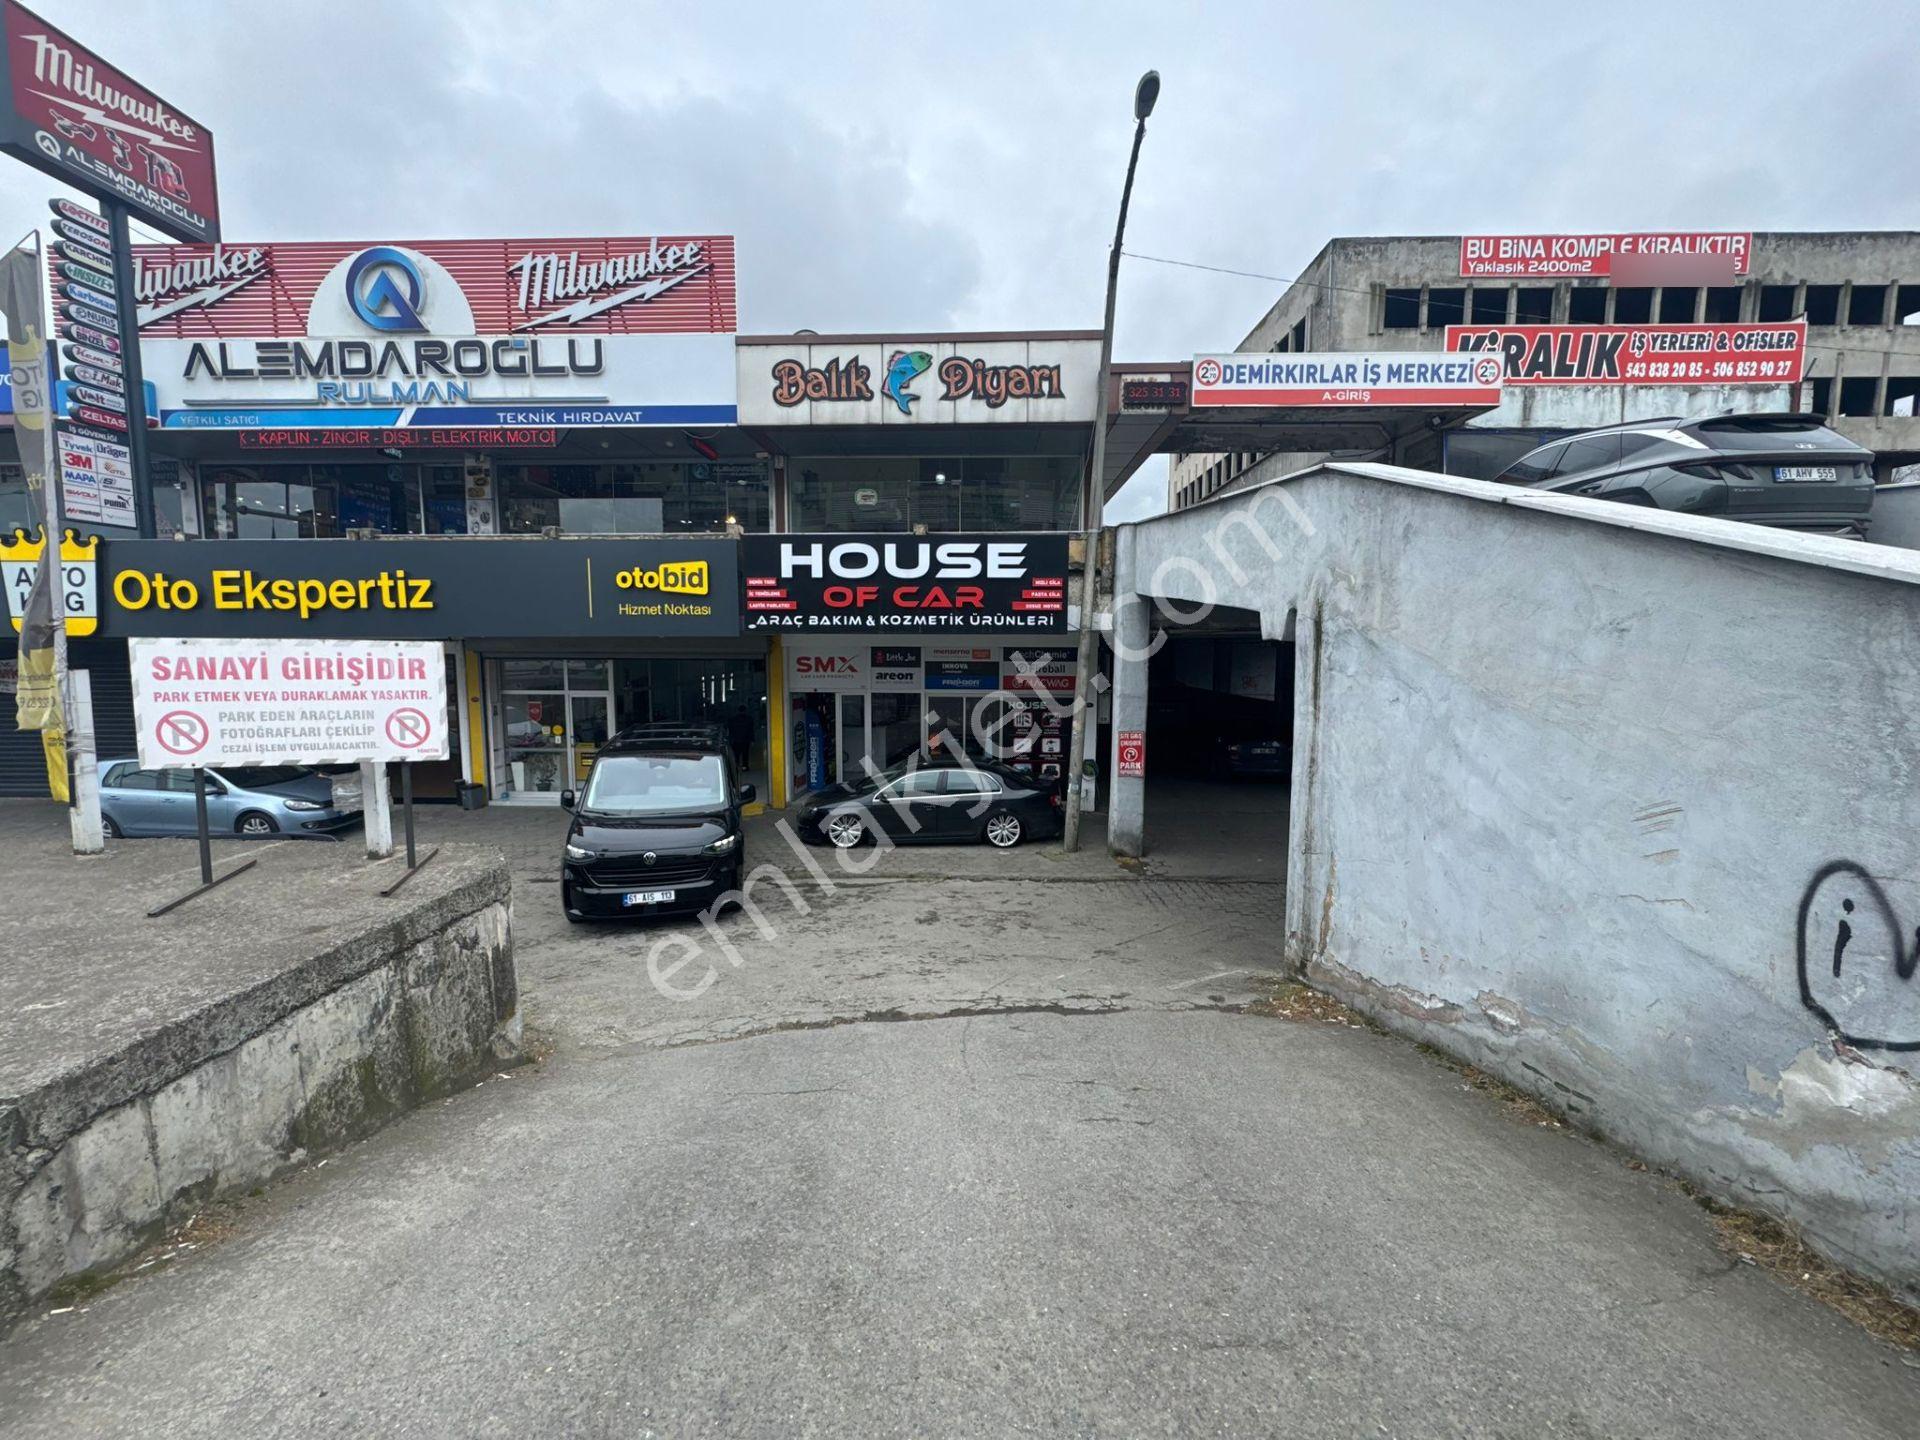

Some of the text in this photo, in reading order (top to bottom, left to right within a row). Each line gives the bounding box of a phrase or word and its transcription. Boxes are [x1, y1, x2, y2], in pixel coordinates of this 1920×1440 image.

[19, 34, 197, 142] Milwaukee
[115, 183, 166, 214] RULMAN
[60, 202, 108, 230] LOCTITE
[62, 223, 109, 249] TEROSON
[1466, 239, 1494, 259] BU
[1551, 237, 1633, 258] KOMPLE
[132, 243, 265, 301] lwaukee
[507, 237, 702, 311] Milwaukee
[1467, 260, 1593, 274] Yaklaşık 2400m2
[72, 267, 108, 289] INSIZE
[69, 284, 116, 311] Karbosan
[1716, 331, 1728, 351] &
[1201, 366, 1209, 379] 2
[1222, 357, 1475, 386] DEMİRKIRLAR İŞ MERKEZİ
[1480, 365, 1488, 378] 2
[1625, 363, 1646, 377] 543
[1649, 363, 1669, 377] 838
[1671, 363, 1686, 377] 20
[1689, 362, 1702, 377] 85
[1713, 362, 1733, 377] 506
[1736, 362, 1757, 377] 852
[1759, 361, 1774, 376] 90
[1776, 361, 1792, 376] 27
[316, 380, 471, 406] RULMAN
[1129, 386, 1181, 398] 325 31 31
[1322, 389, 1371, 402] A-GİRİŞ
[223, 415, 259, 425] SATICI
[496, 408, 643, 424] TEKNİK HIRDAVAT
[63, 440, 92, 454] Tyvek
[96, 442, 128, 459] Dräger
[65, 452, 92, 470] 3M
[65, 470, 97, 484] MAPA
[1781, 468, 1835, 478] 61 AHV 555
[104, 498, 127, 509] PUMA
[780, 541, 1028, 579] HOUSE
[15, 566, 86, 588] AO
[20, 591, 85, 612] KG
[113, 569, 434, 620] Oto Ekspertiz
[823, 586, 984, 608] OF CAR
[619, 603, 712, 616] Hizmet Noktası
[756, 612, 1055, 628] ARAÇ BAKIM & KOZMETİK ÜRÜNLERİ
[152, 651, 427, 687] SANAYİ GİRİŞİDİR
[796, 655, 859, 673] SMX
[875, 671, 914, 681] areon
[153, 689, 433, 703] PARK ETMEK VEYA DURAKLAMAK YASAKTIR.
[219, 709, 375, 723] PARK EDEN ARAÇLARIN
[220, 723, 375, 739] FOTOĞRAFLARI ÇEKİLİP
[255, 743, 287, 755] İŞLEM
[290, 741, 380, 752] UYGULANACAKTIR.
